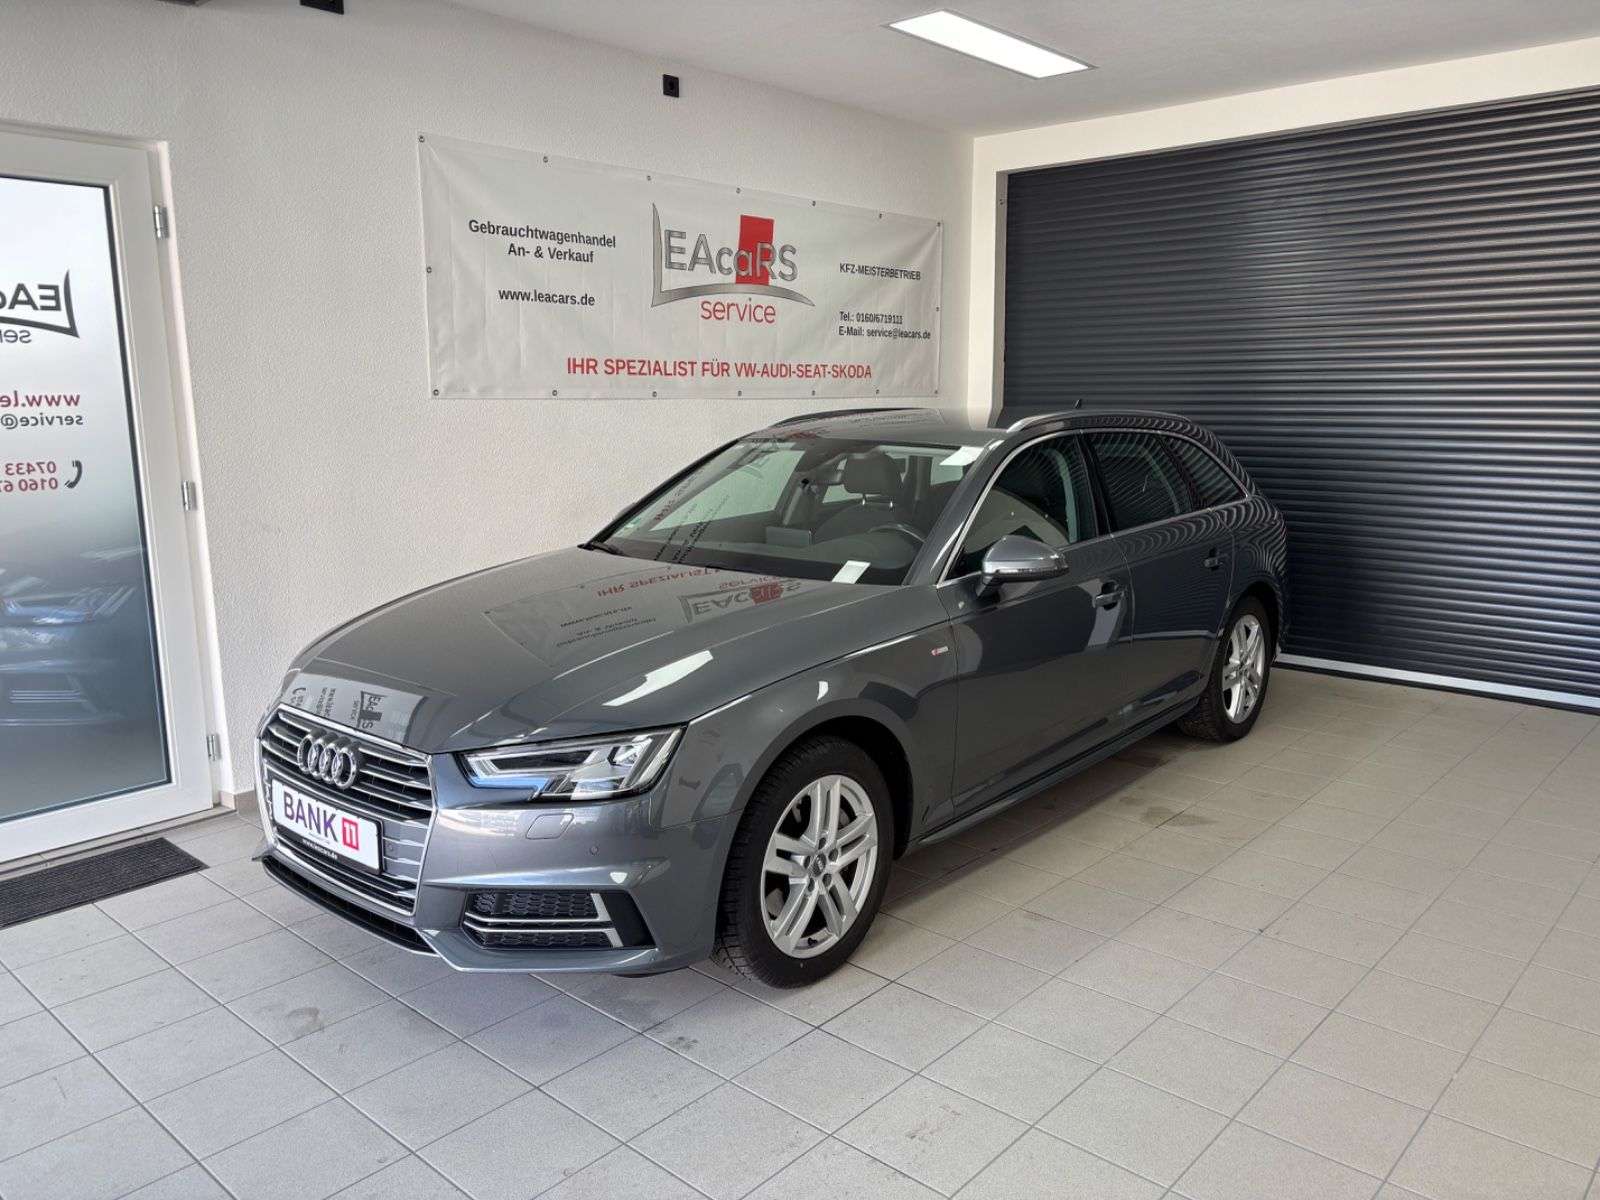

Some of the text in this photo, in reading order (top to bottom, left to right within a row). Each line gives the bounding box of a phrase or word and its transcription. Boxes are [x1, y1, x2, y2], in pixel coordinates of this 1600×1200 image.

[468, 219, 616, 248] Gebrauchtwagenhandel
[508, 243, 594, 263] An- & Verkauf
[840, 263, 921, 280] KFZ-MEISTERBETRIEB
[498, 289, 596, 306] www.leacars.de
[701, 298, 776, 324] service
[839, 326, 931, 340] E-Mail: service@leacars.de
[567, 357, 872, 379] IHR SPEZIALIST FÜR VW-AUDI-SEAT-SKODA
[284, 791, 338, 843] BANK
